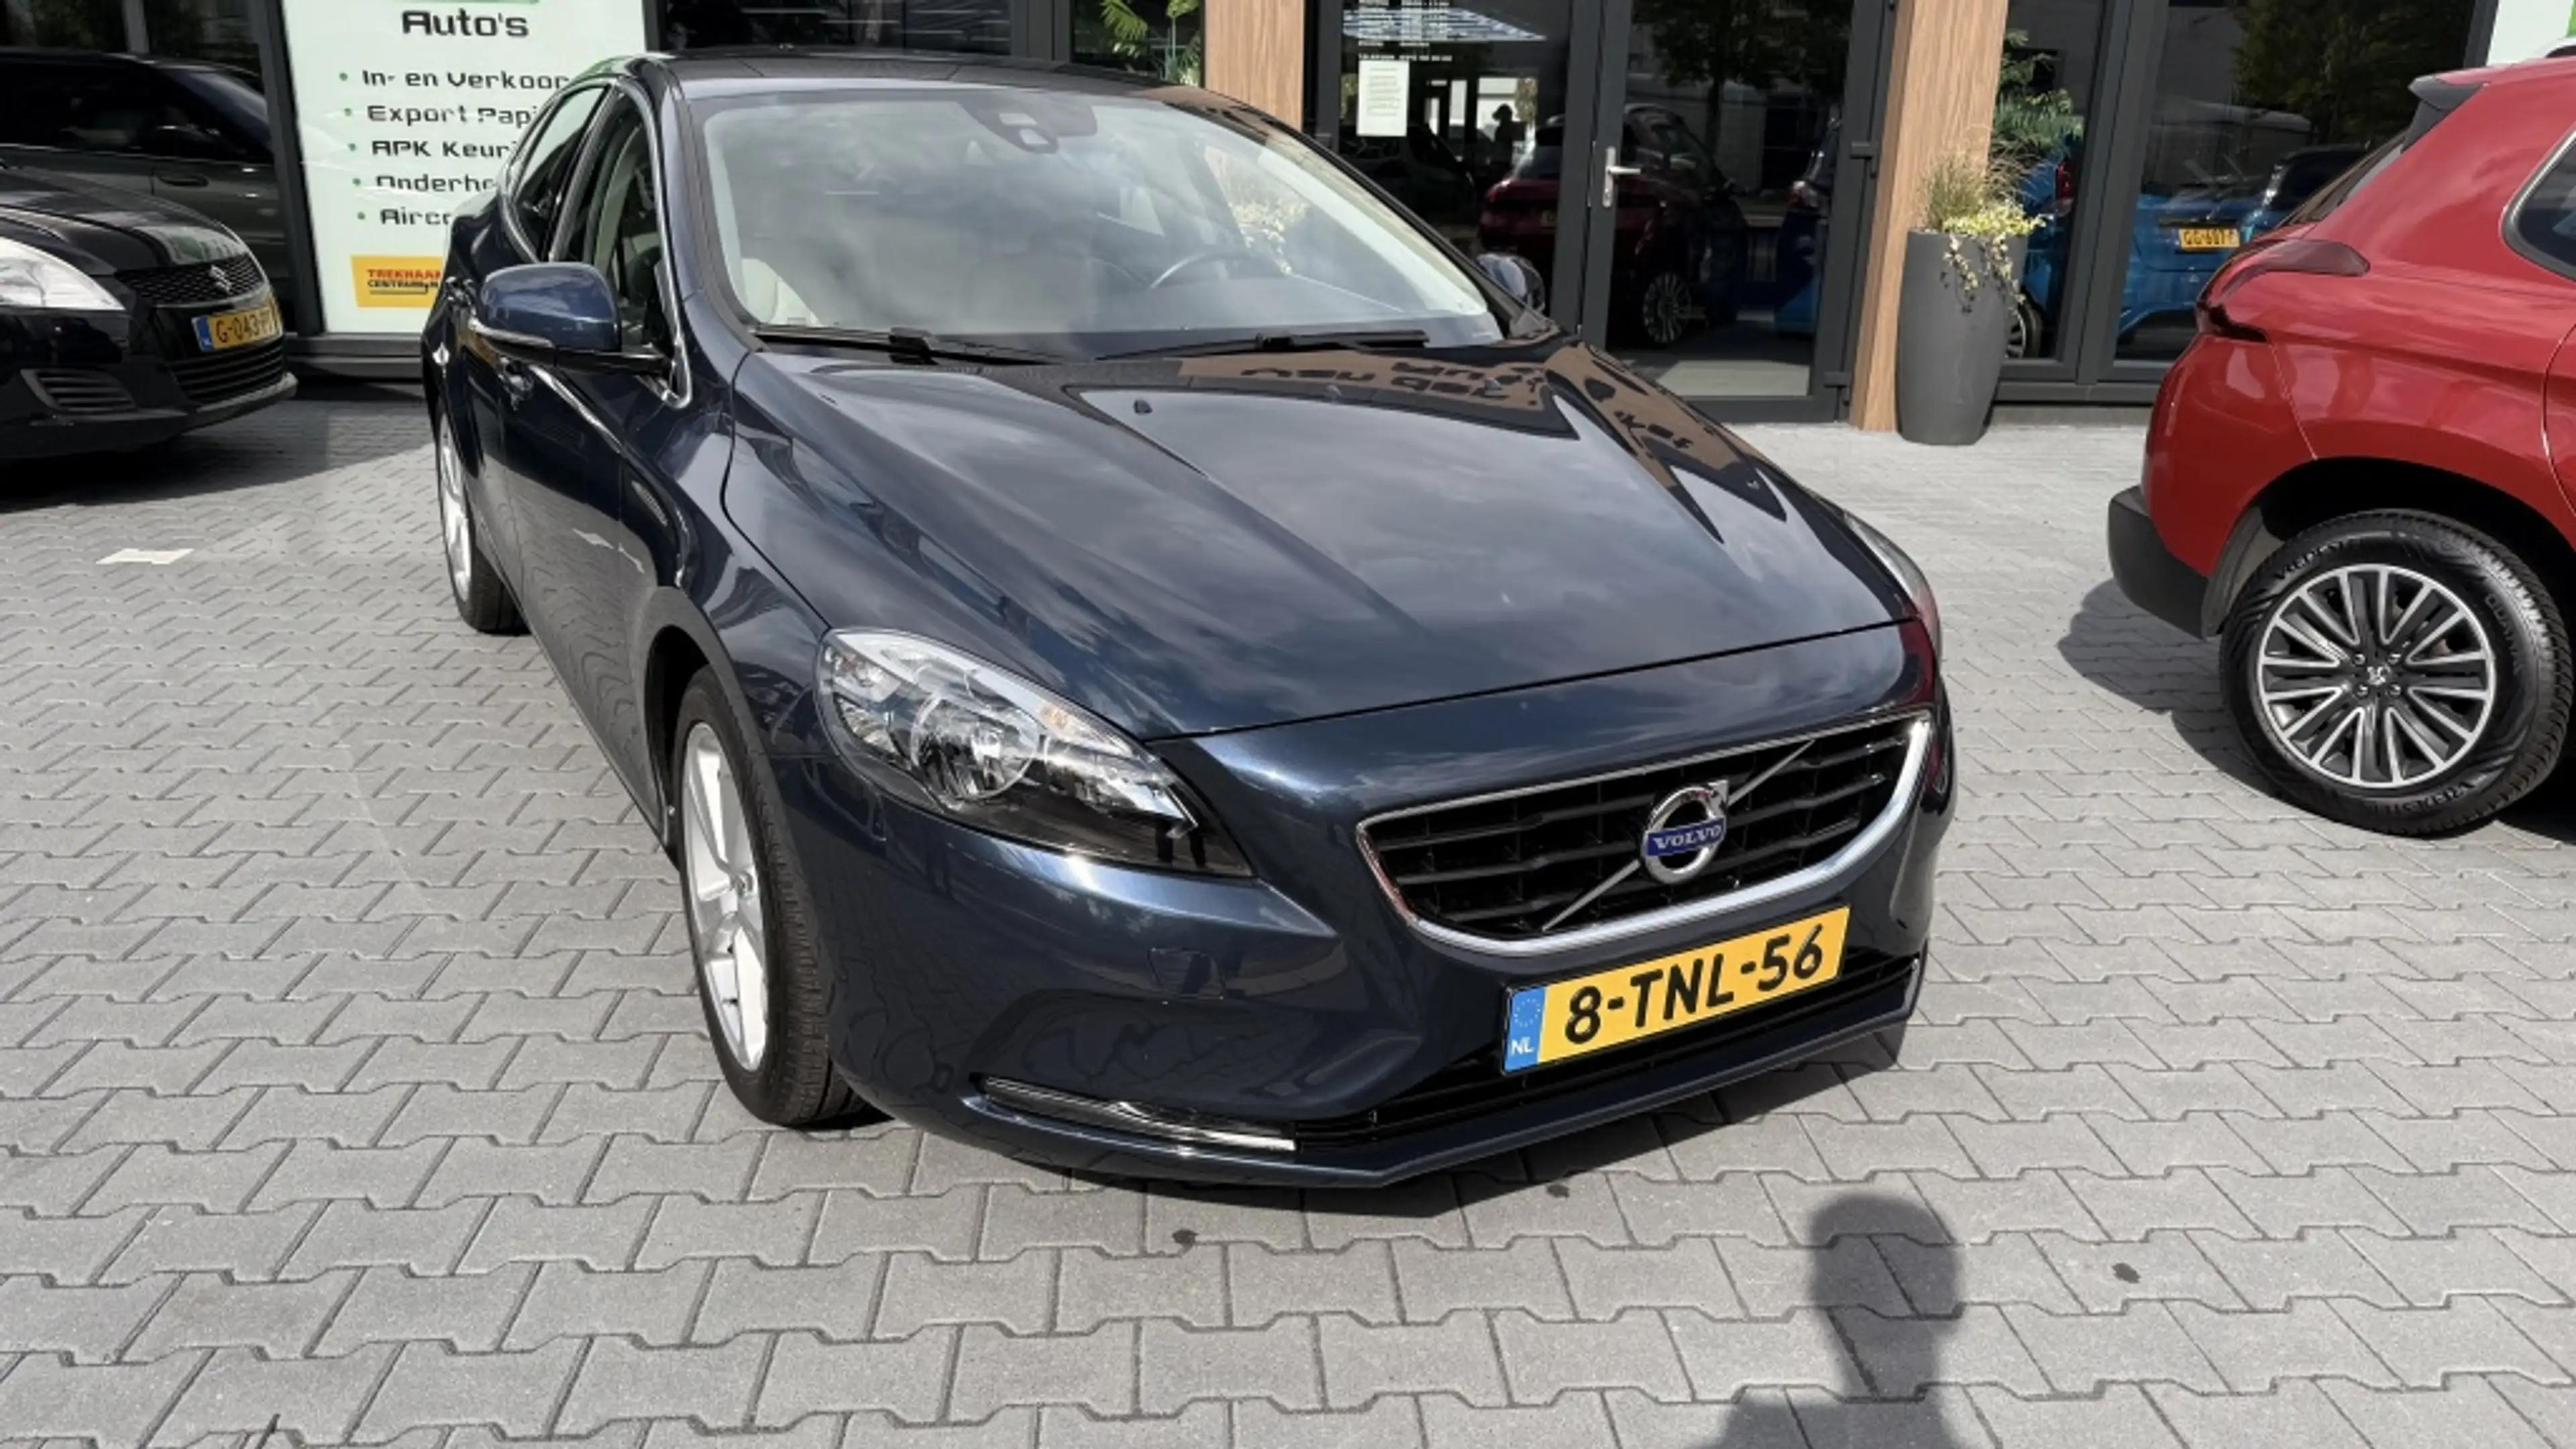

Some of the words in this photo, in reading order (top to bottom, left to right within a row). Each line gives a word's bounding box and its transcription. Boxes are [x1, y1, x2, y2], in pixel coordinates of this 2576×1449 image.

[402, 7, 529, 37] Auto's
[362, 70, 396, 87] In-
[405, 72, 439, 87] en
[368, 105, 467, 127] Export
[477, 105, 537, 129] Pap
[372, 140, 431, 157] APK
[442, 140, 517, 158] Keur
[1653, 824, 1722, 849] VOLVO
[1564, 923, 1823, 1044] 8-TNL-56
[1511, 1038, 1535, 1056] NL
